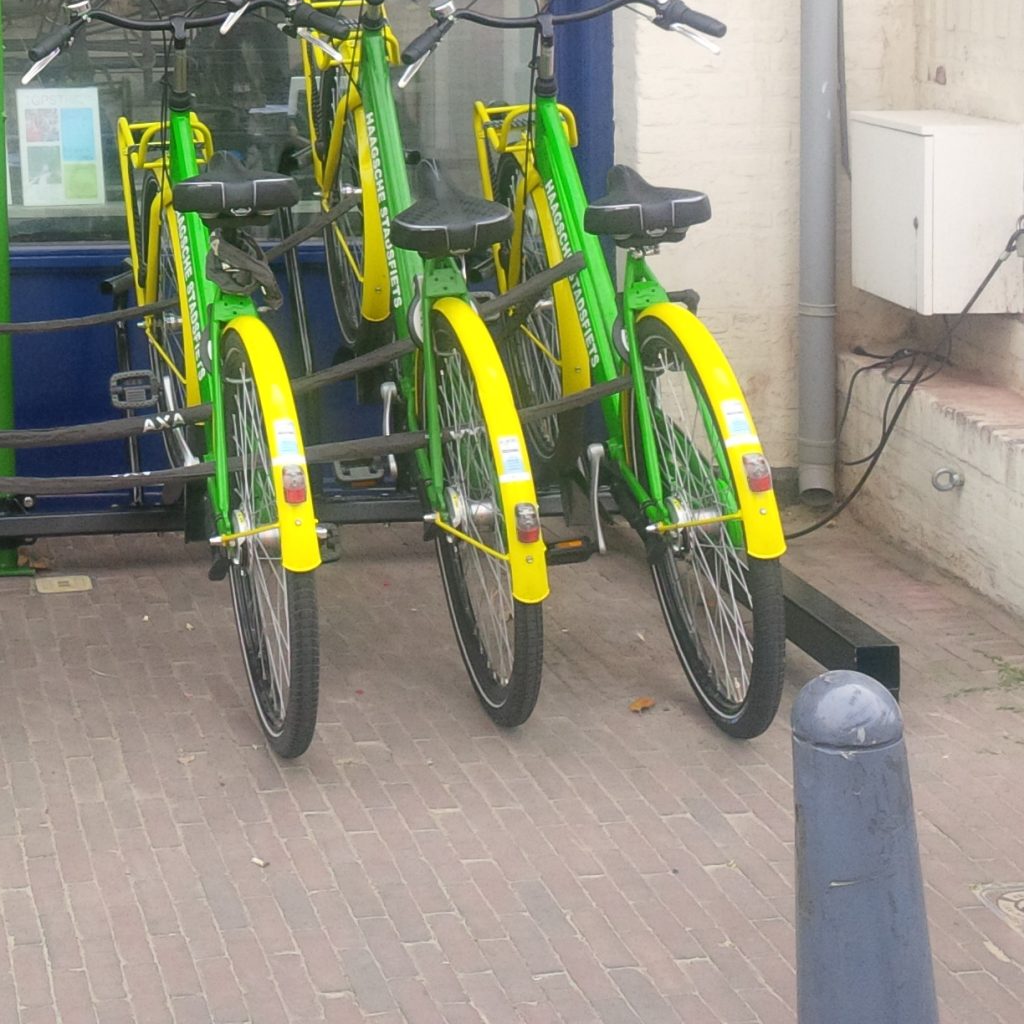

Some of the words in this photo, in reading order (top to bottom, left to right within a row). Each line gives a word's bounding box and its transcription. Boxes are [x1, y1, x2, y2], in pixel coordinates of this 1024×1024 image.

[364, 111, 387, 204] HAAGSCHE
[175, 211, 193, 281] AGSCHE
[544, 178, 573, 259] HAAGSCH
